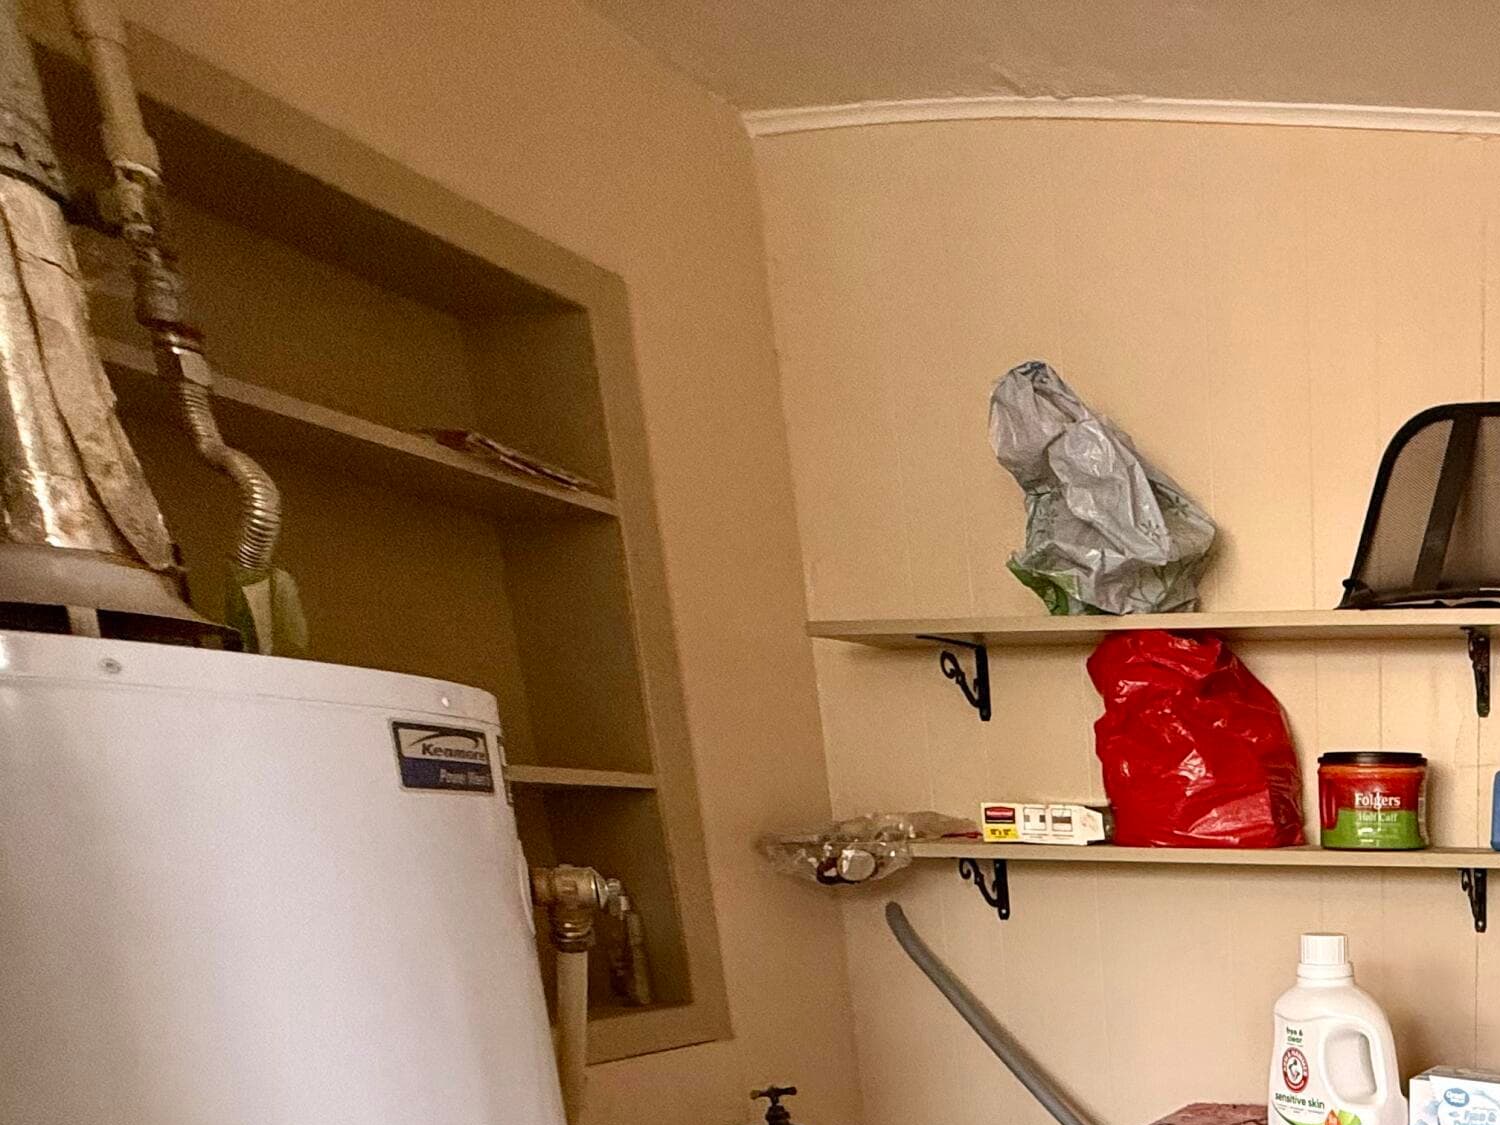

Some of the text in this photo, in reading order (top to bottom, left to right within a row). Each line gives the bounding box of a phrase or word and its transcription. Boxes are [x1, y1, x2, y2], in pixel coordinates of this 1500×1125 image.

[1354, 791, 1401, 809] Folgers
[1275, 1092, 1325, 1109] sensitive skin
